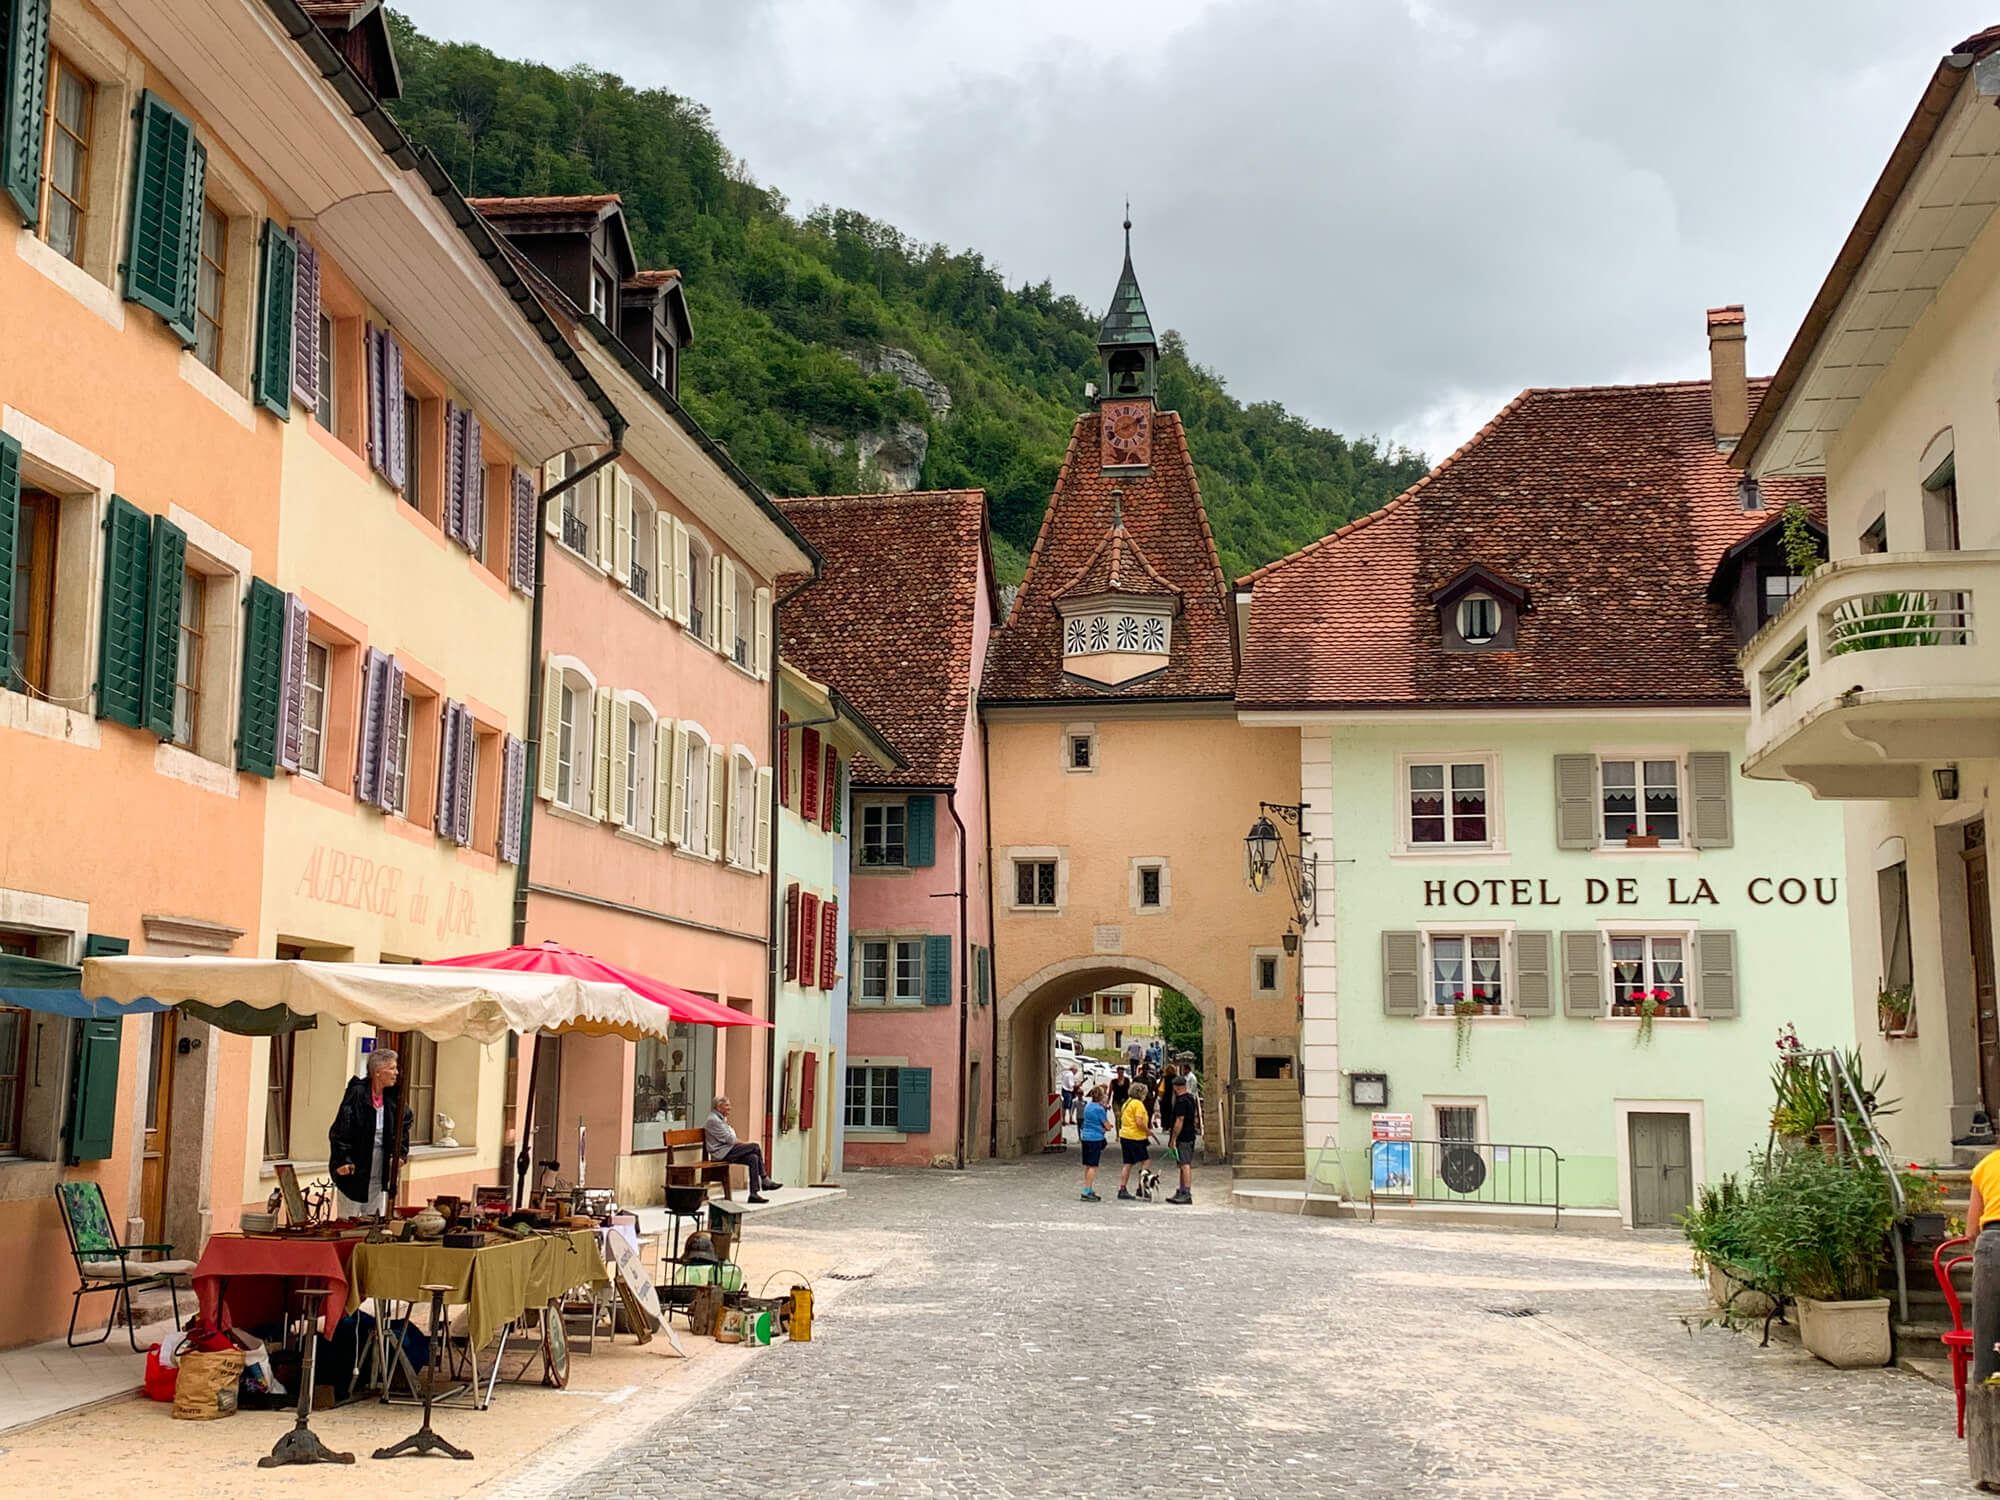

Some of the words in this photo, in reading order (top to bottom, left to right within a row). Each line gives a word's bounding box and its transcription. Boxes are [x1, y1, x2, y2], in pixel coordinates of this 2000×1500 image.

[295, 845, 403, 919] AUBERGE
[409, 876, 429, 925] du
[1423, 878, 1561, 906] HOTEL
[1584, 877, 1639, 905] DE
[1667, 877, 1721, 905] LA
[1746, 876, 1839, 905] COU
